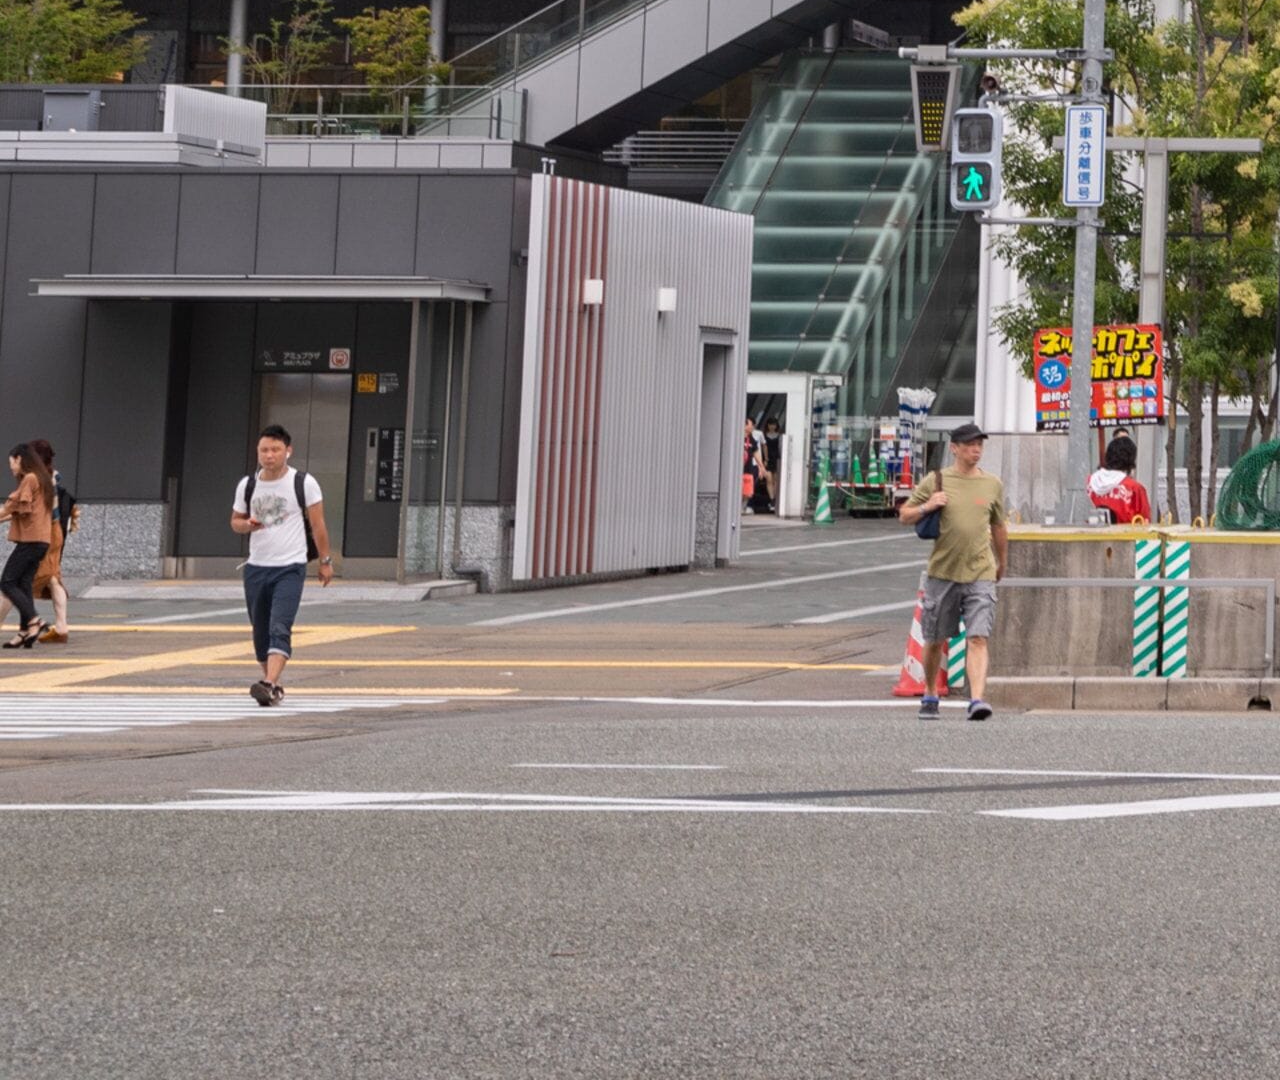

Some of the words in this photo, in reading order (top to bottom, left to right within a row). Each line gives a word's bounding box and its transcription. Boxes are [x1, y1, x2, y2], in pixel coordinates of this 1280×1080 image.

[1077, 110, 1094, 201] 歩車分離信号
[1040, 328, 1151, 355] ネッカフェ
